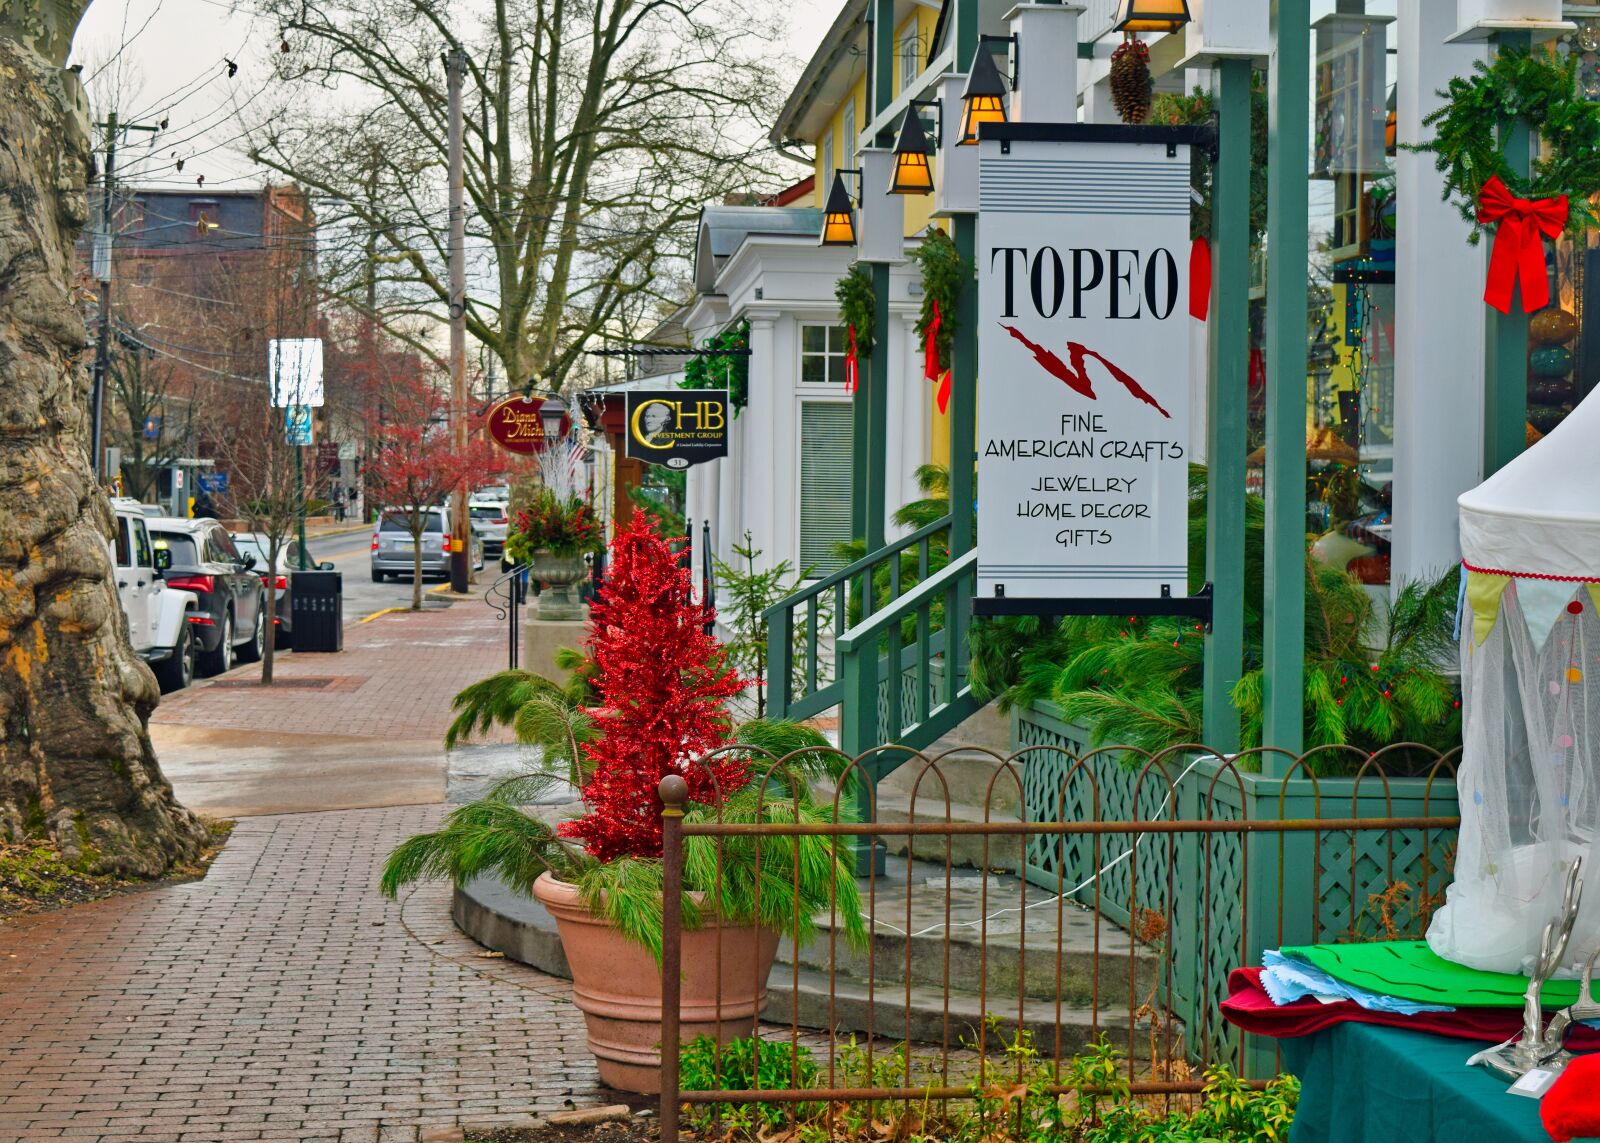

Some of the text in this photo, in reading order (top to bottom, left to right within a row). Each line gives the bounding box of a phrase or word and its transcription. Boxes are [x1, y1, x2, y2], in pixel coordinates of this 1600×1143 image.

[991, 245, 1179, 321] TOPEO
[502, 406, 536, 423] Diana
[1061, 411, 1108, 436] FINE
[697, 431, 723, 439] GROUP
[984, 437, 1184, 463] AMERICAN CRAFTS
[1031, 474, 1138, 494] JEWELRY
[1016, 500, 1151, 520] HOME DECOR
[1055, 529, 1112, 547] GIFTS
